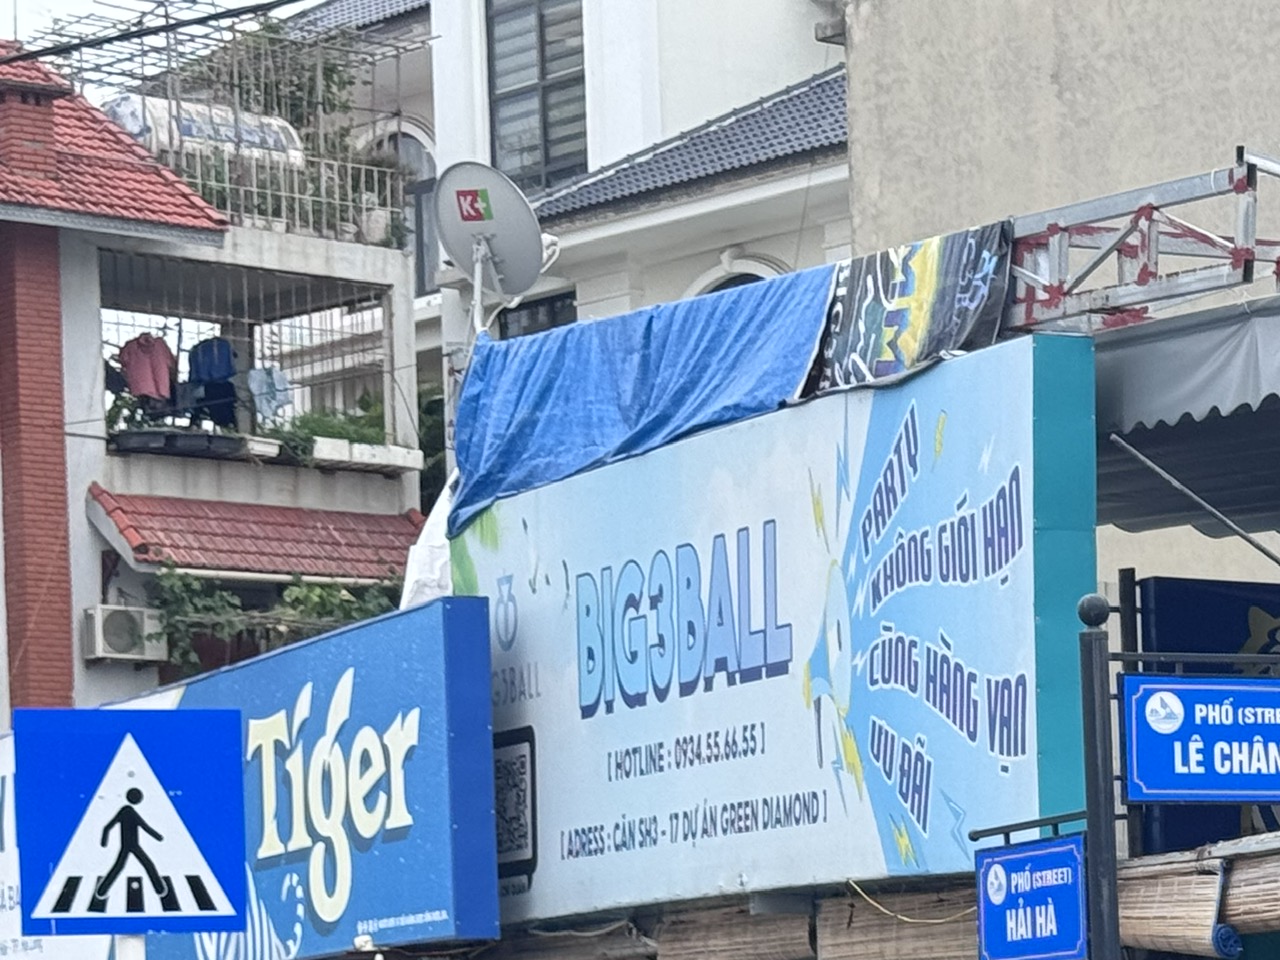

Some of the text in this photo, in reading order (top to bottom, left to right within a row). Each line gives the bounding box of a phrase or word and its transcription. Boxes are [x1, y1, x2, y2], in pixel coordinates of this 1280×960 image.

[861, 403, 919, 559] PARTY
[982, 464, 1023, 586] HẠN
[576, 518, 793, 720] BIG3BALL
[925, 630, 979, 743] HÀNG
[986, 673, 1027, 773] VẠN
[1194, 697, 1235, 726] PHỐ
[615, 741, 664, 781] HOTLINE
[674, 723, 758, 770] 0934.55.66.55
[1173, 734, 1206, 775] LÊ
[246, 666, 421, 923] Tiger
[567, 824, 605, 860] ADRESS
[721, 798, 759, 836] GREEN
[762, 790, 819, 831] DIAMOND
[1010, 862, 1072, 894] PHỐ (STREET)
[1006, 897, 1058, 942] HẢI HÀ
